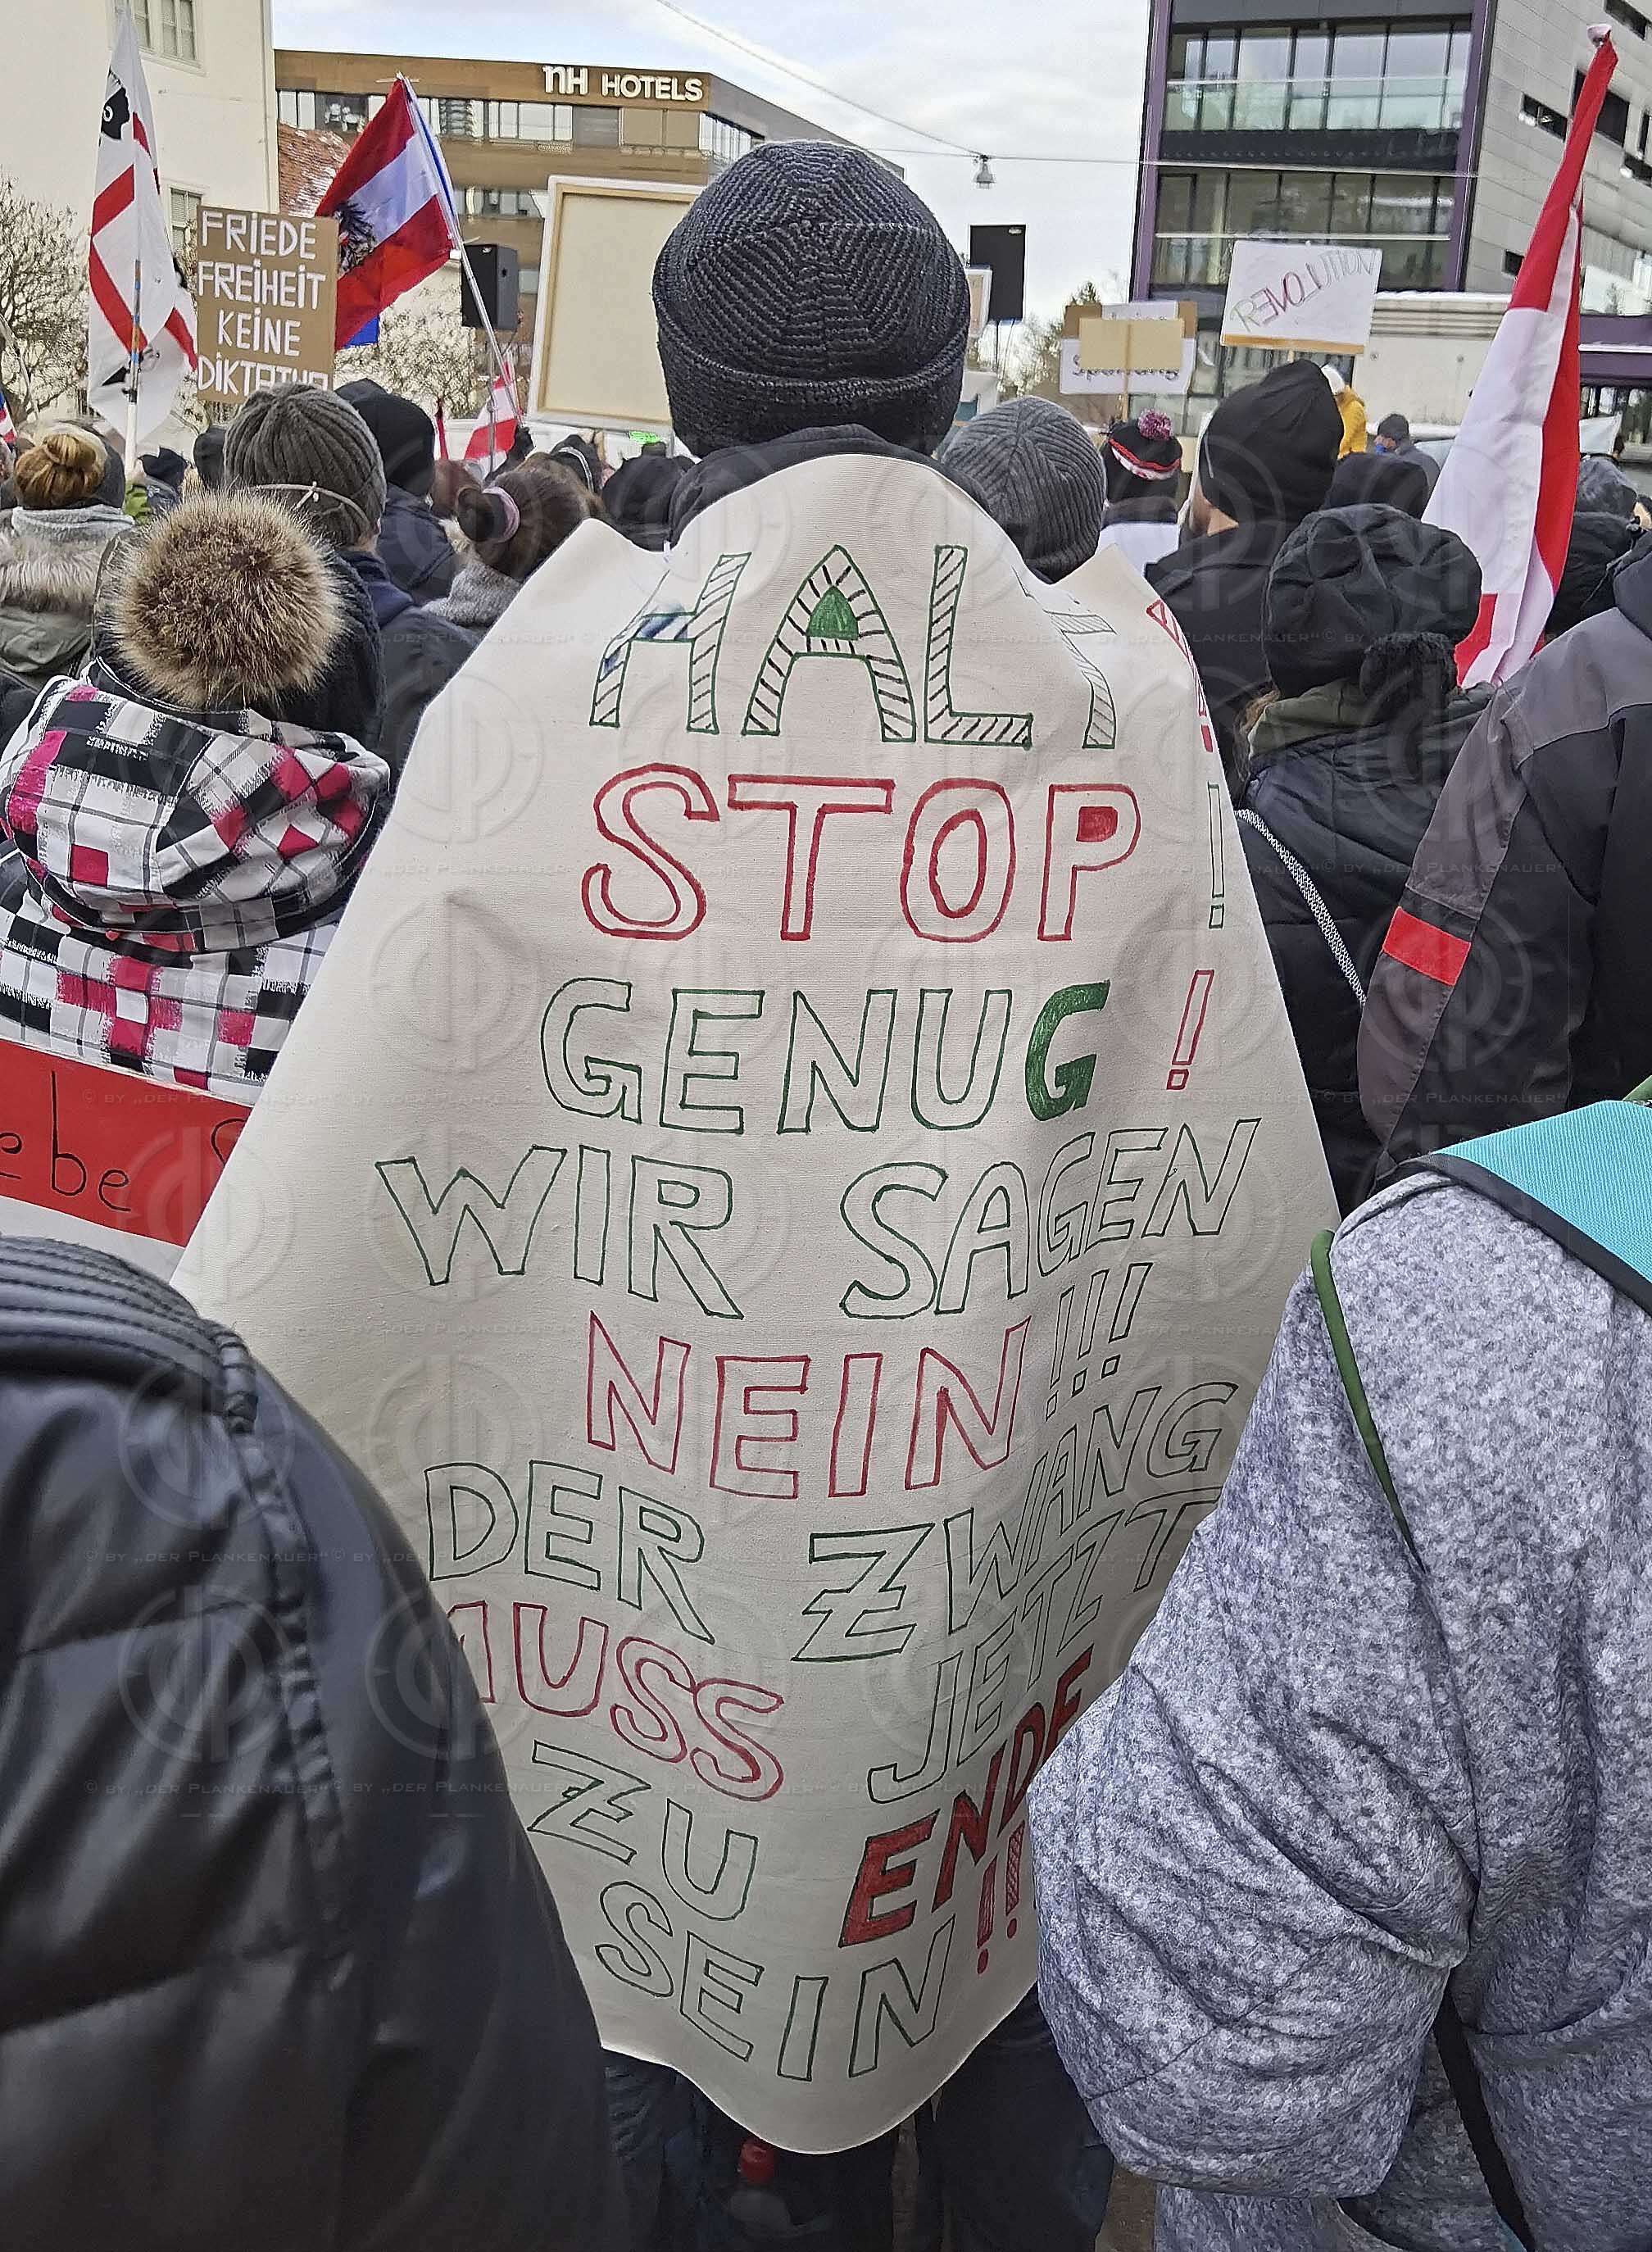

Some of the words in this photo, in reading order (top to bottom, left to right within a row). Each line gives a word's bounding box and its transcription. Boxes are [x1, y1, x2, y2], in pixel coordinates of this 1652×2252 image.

[601, 73, 703, 102] HOTELS
[582, 763, 1141, 942] STOP
[541, 977, 1111, 1134] GENUG
[375, 1145, 744, 1319] WIR
[840, 1118, 1262, 1319] SAGEN
[588, 1312, 1031, 1499] NEIN
[424, 1460, 715, 1645] DER
[791, 1381, 1239, 1663] ZWANG
[866, 1486, 1223, 1805] JETZT
[527, 1740, 759, 1922] ZU
[595, 1880, 956, 2082] SEIN
